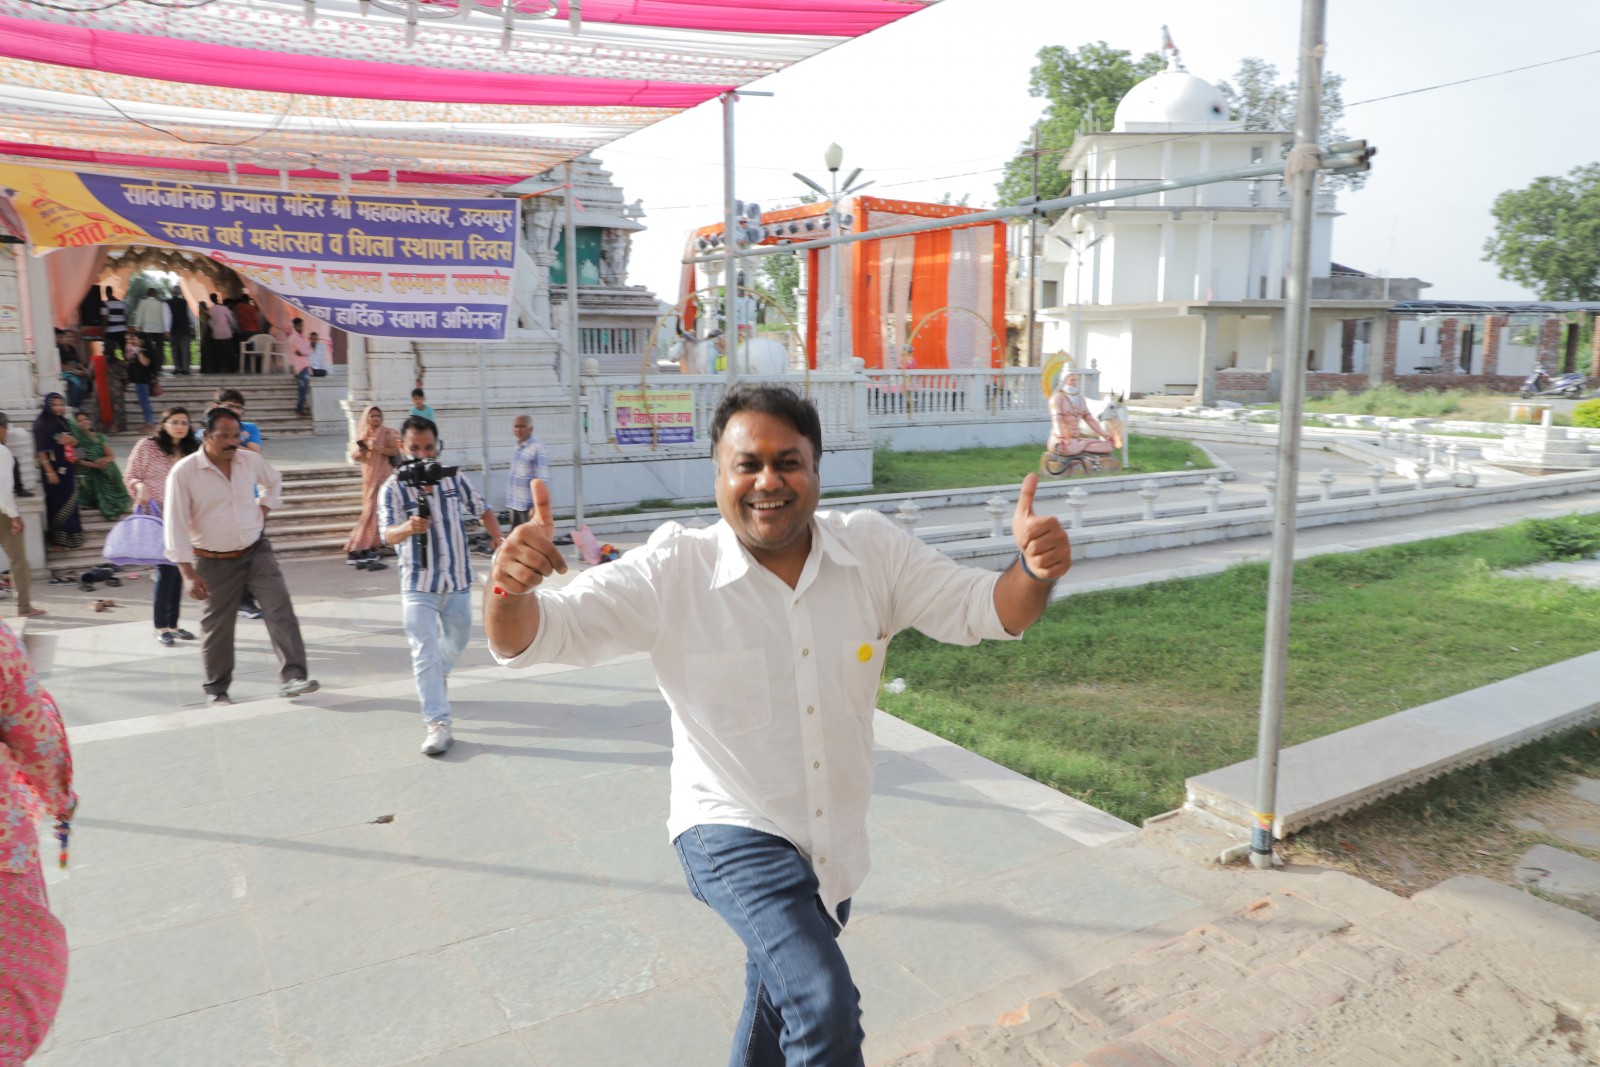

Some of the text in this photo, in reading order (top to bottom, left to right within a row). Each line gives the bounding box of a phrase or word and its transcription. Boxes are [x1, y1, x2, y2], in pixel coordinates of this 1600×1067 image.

[120, 181, 513, 233] सार्वजनिक प्रन्यास मंदिर श्री महाकालेश्वर, उदयपुर
[157, 221, 210, 243] रजत
[213, 221, 244, 247] वर्ष
[248, 224, 324, 254] महोत्सव
[328, 233, 344, 255] व
[347, 228, 394, 258] शिला
[397, 237, 464, 260] स्थापना
[467, 234, 513, 262] दिवस
[334, 303, 385, 327] हार्दिक
[386, 310, 438, 329] स्वागत
